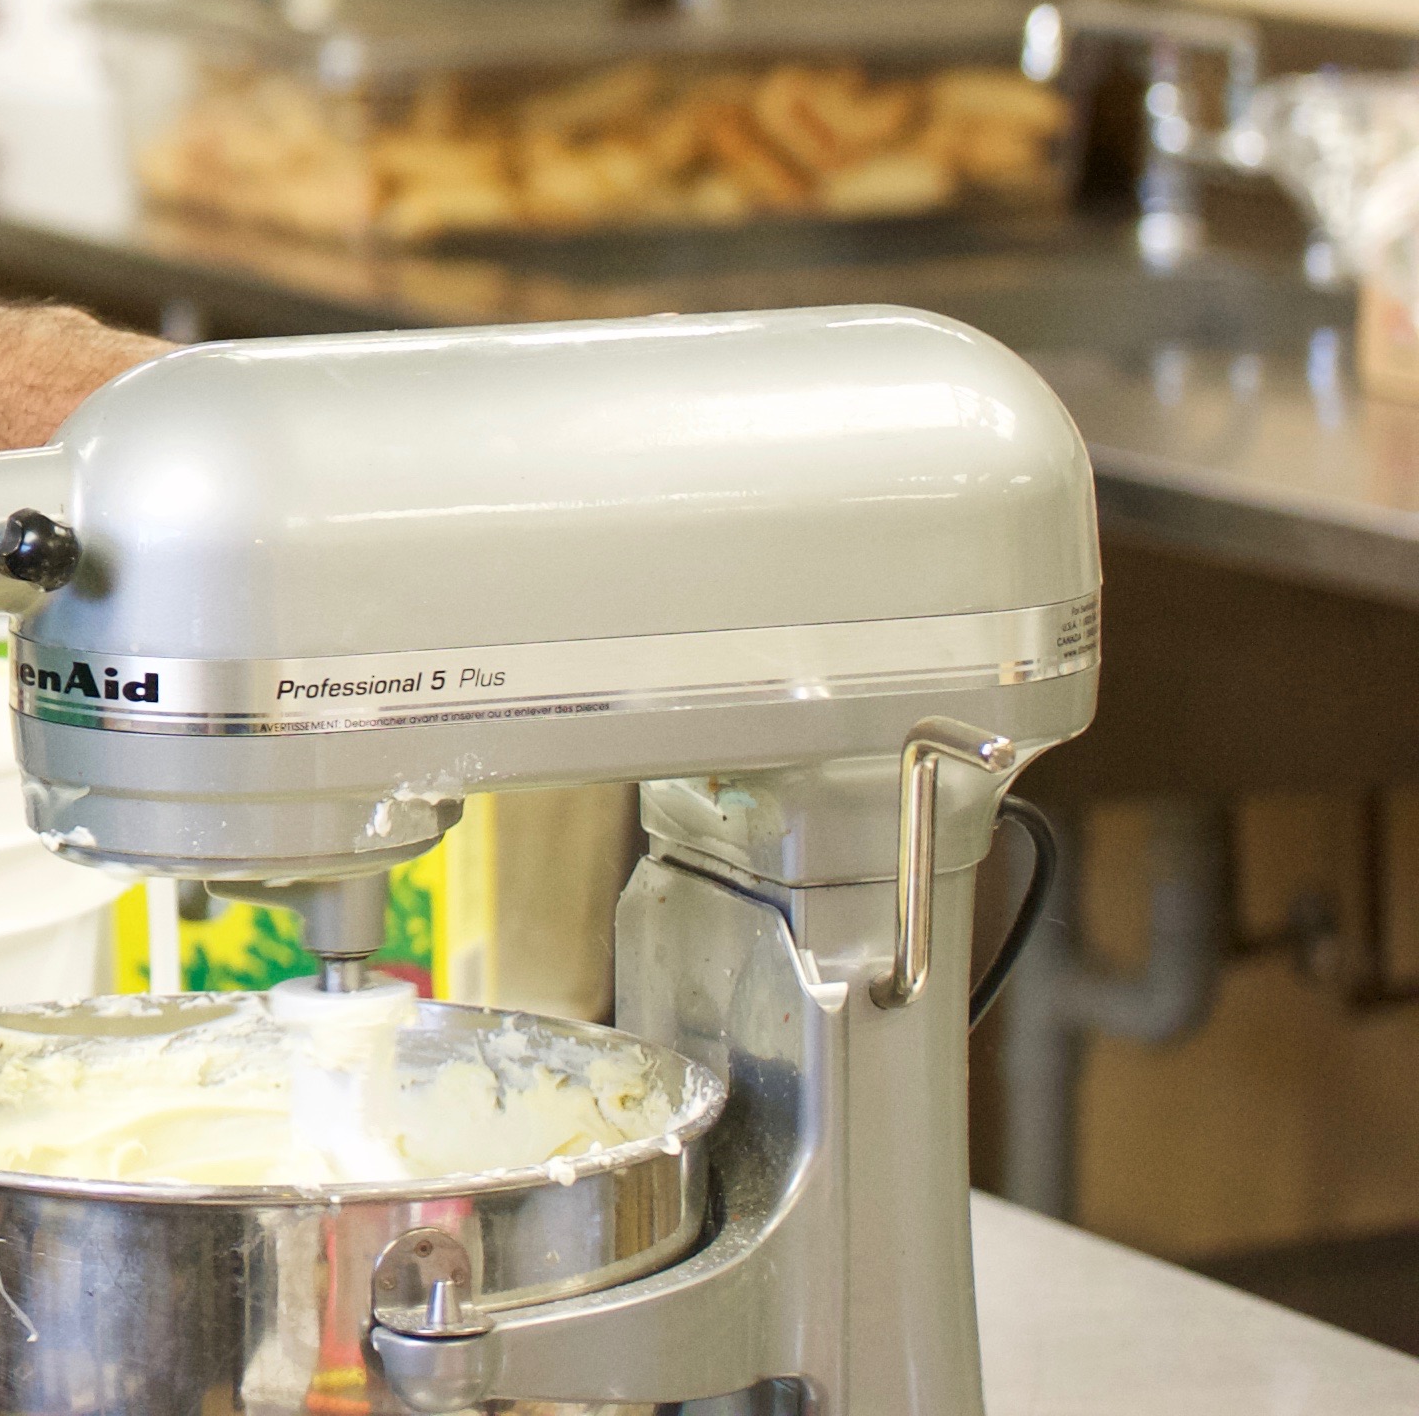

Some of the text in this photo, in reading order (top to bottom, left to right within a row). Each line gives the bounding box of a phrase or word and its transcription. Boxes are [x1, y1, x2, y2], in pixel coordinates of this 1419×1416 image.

[276, 668, 506, 700] Professional 5 Plus
[409, 713, 439, 724] avant
